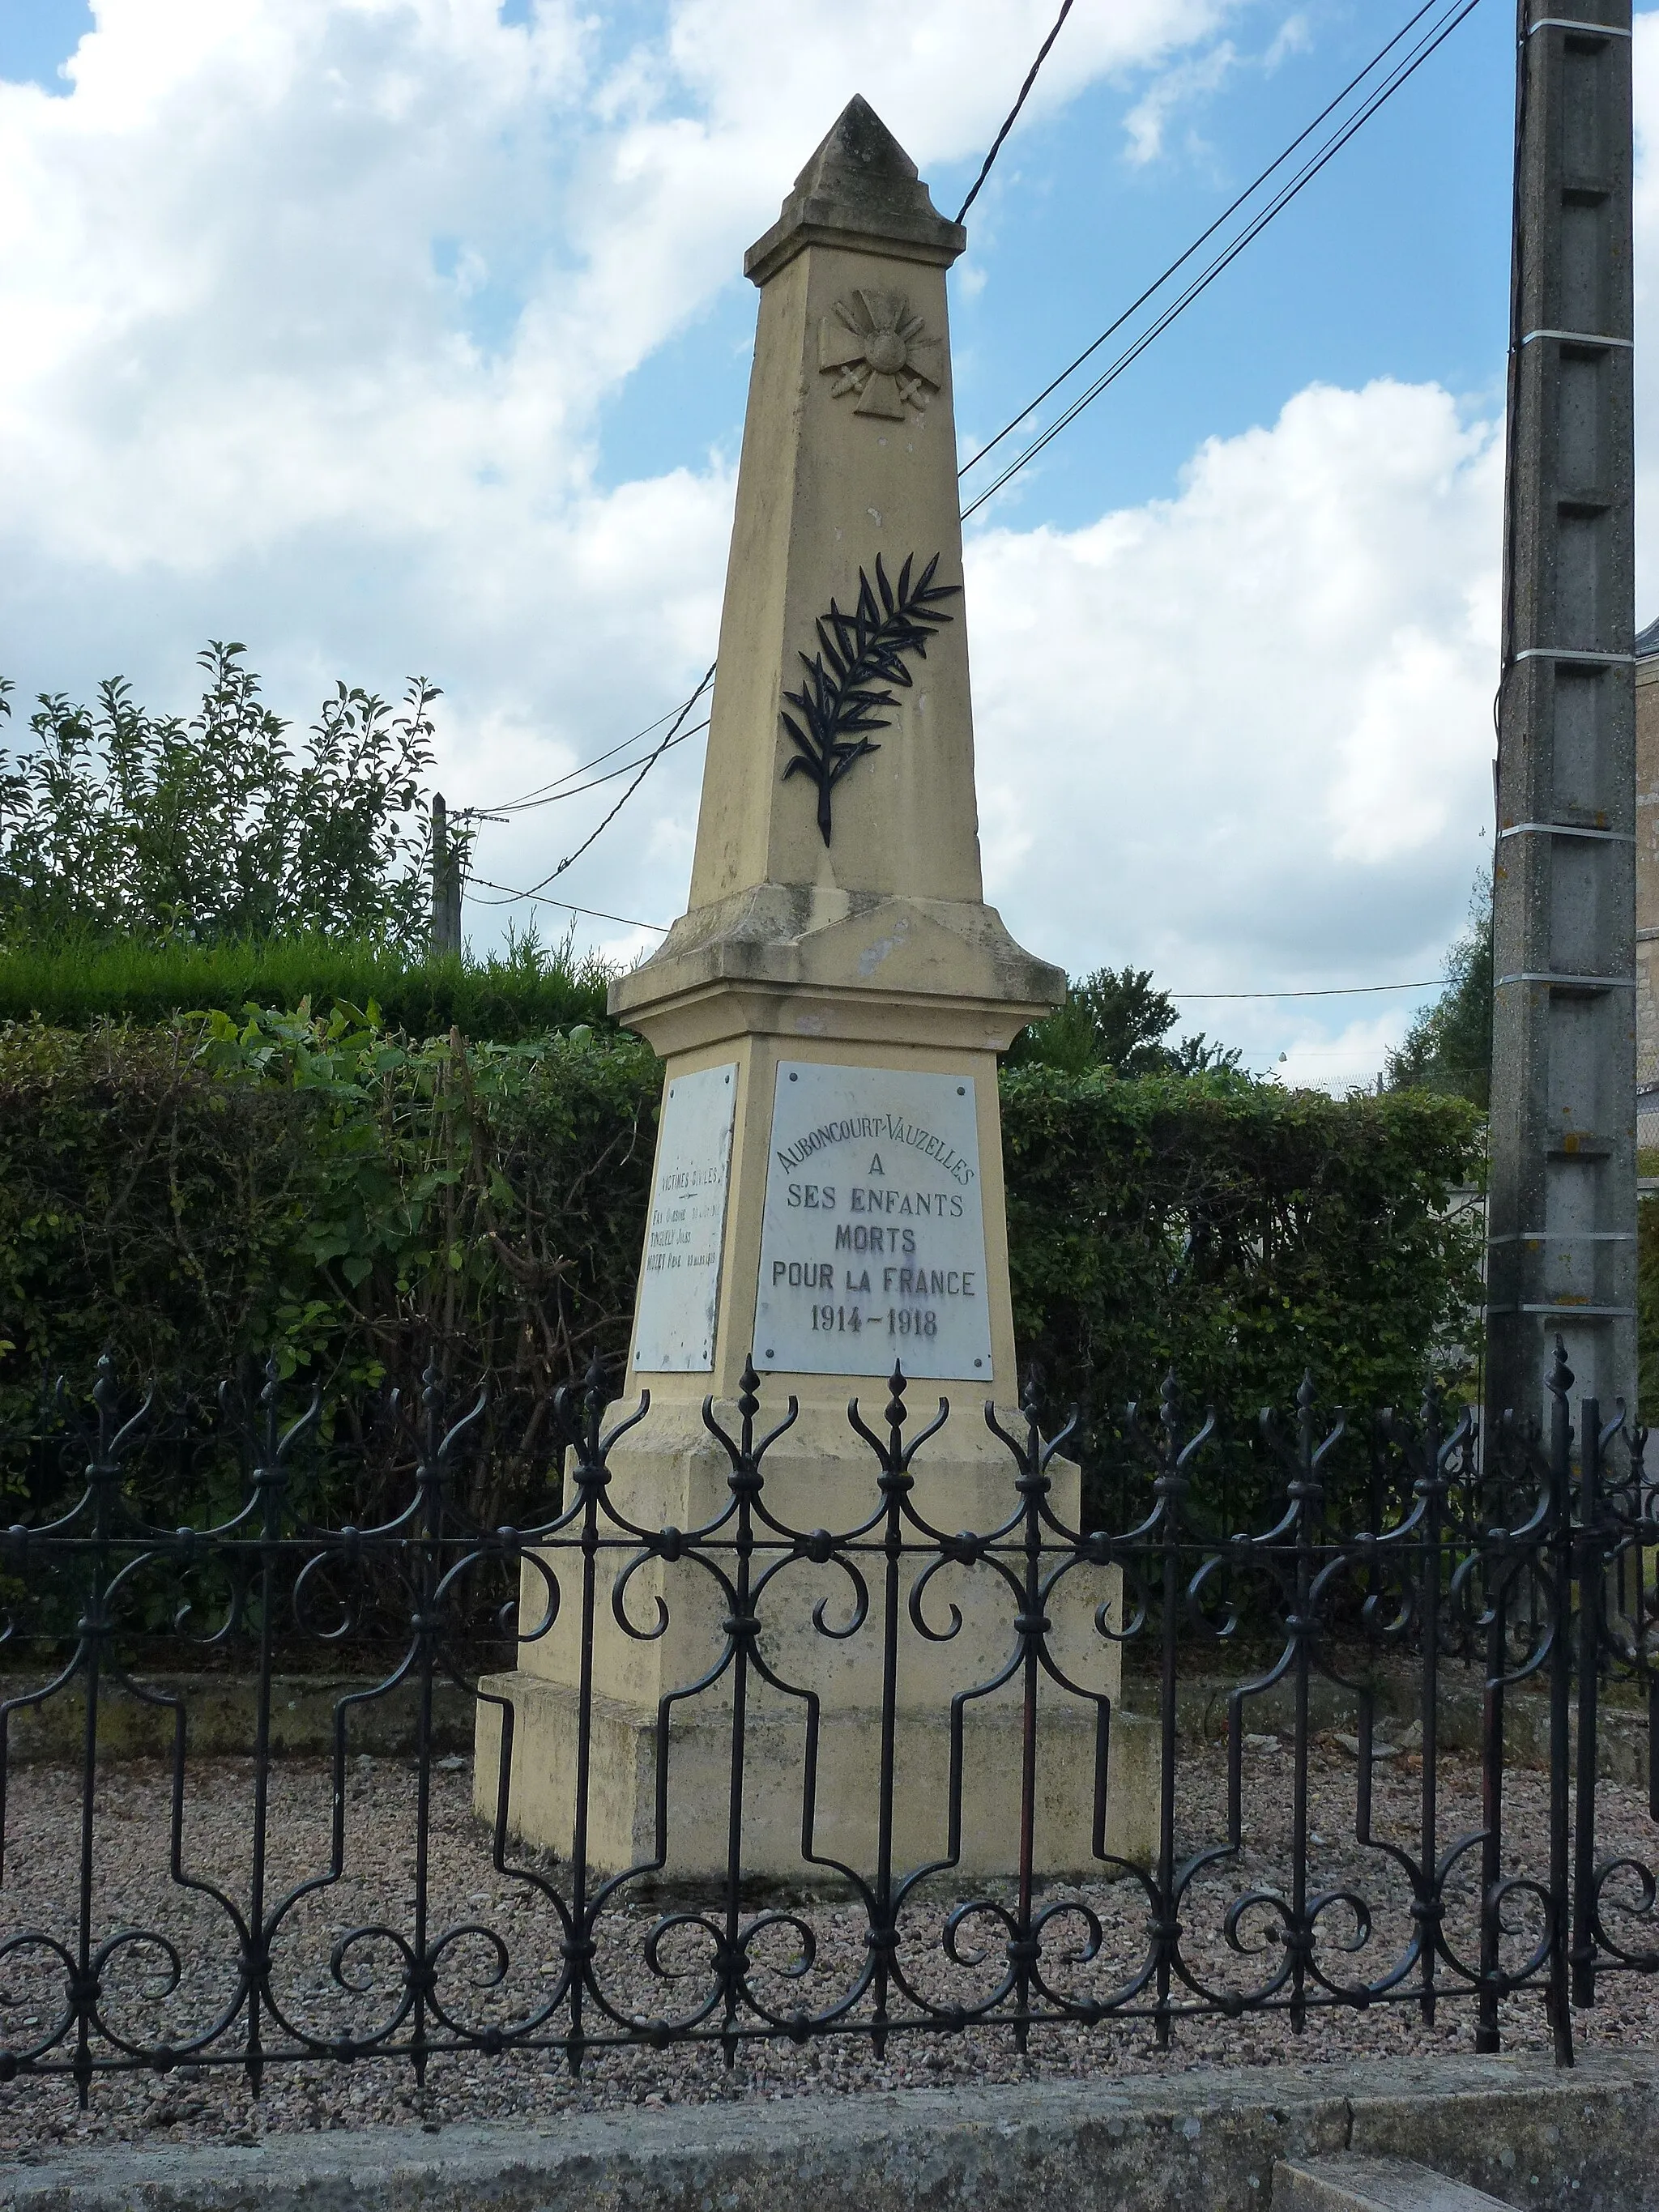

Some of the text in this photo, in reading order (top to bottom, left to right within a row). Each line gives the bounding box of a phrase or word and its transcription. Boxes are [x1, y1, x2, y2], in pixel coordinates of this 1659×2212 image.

[776, 1114, 975, 1186] AUBONCOURT-VAUZELLES
[868, 1153, 885, 1174] A
[787, 1183, 964, 1217] SES ENFANTS
[835, 1224, 917, 1254] MORTS
[772, 1260, 975, 1297] POUR LA FRANCE
